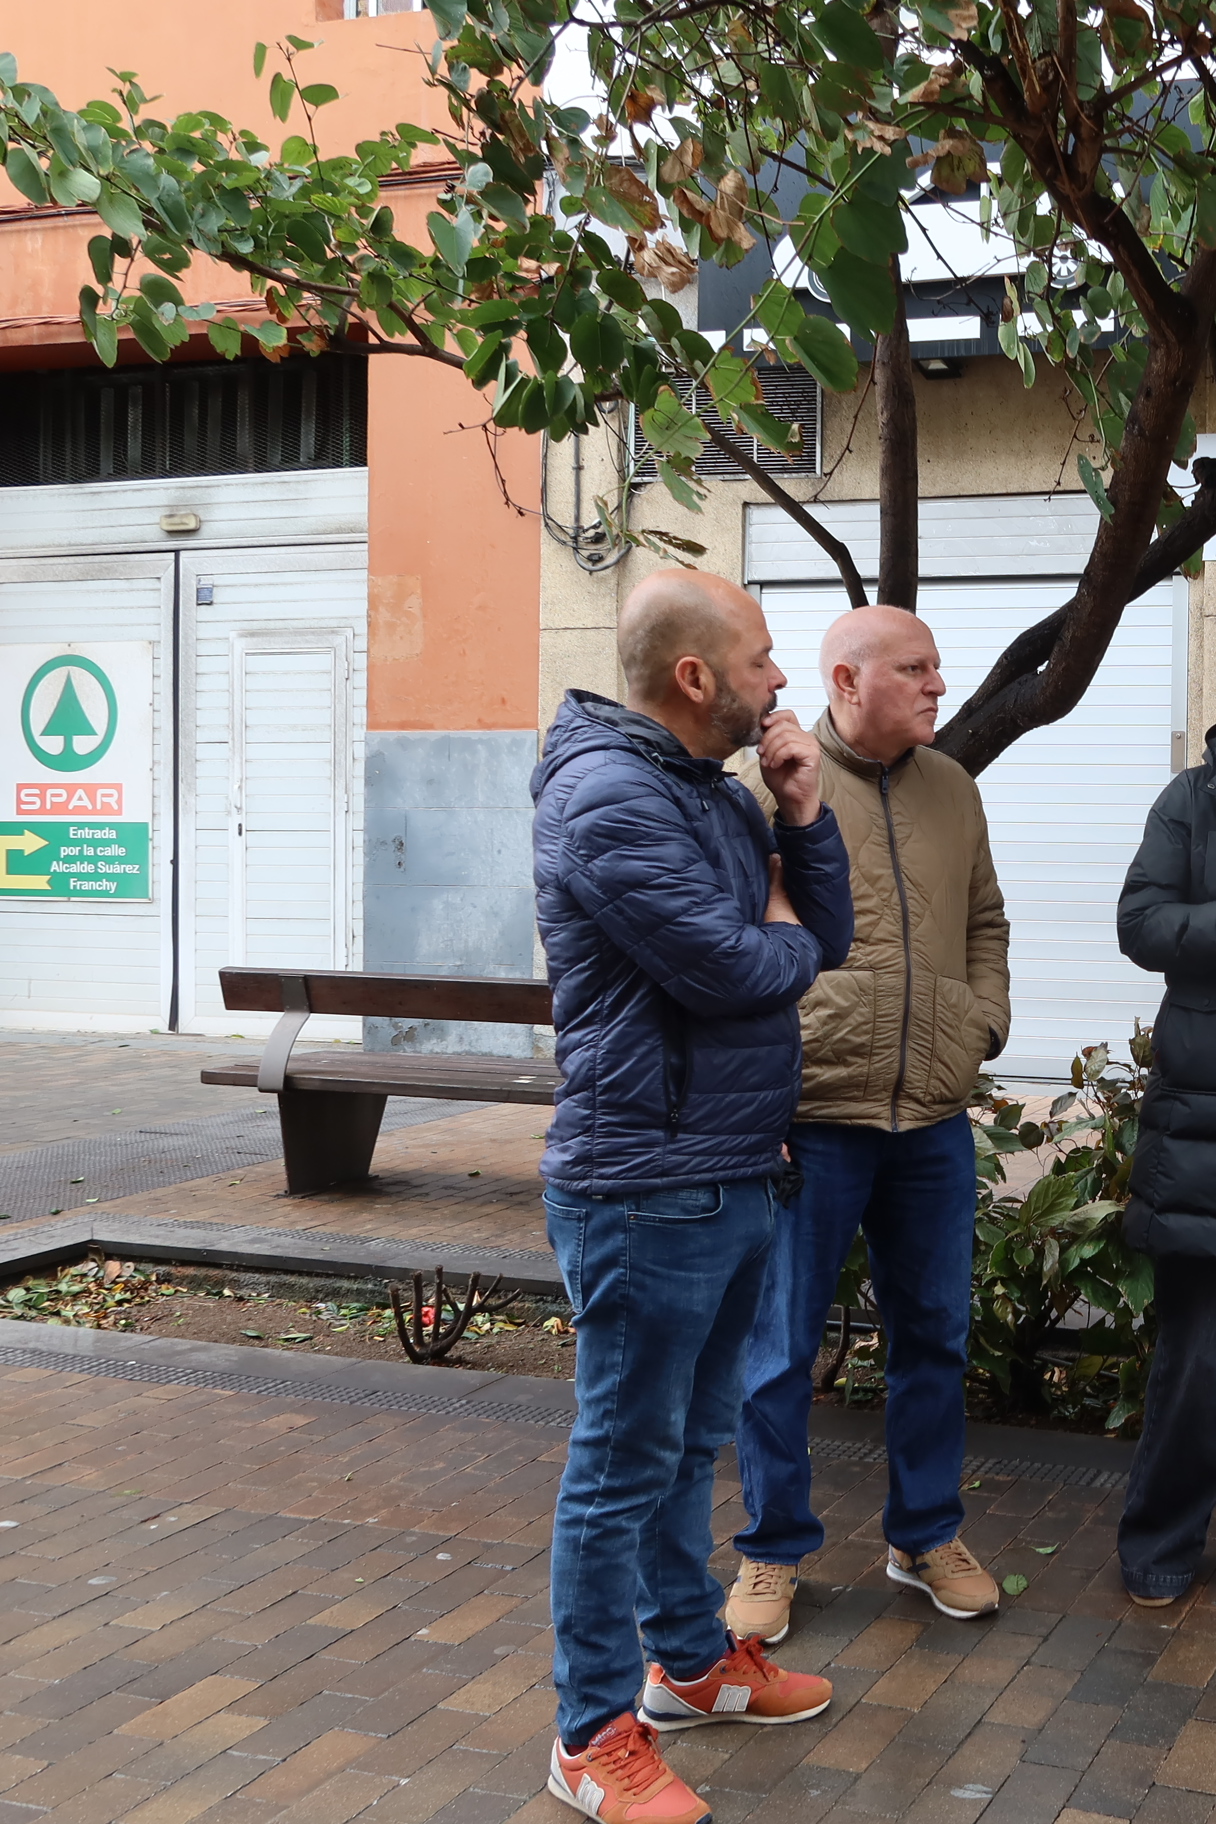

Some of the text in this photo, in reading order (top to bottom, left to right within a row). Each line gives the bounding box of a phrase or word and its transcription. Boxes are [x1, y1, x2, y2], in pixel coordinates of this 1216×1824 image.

[19, 788, 119, 810] SPAR
[69, 826, 117, 839] Entrada
[60, 844, 126, 858] por la calle
[50, 861, 140, 874] Alcalde Suárez
[69, 878, 117, 893] Franchy
